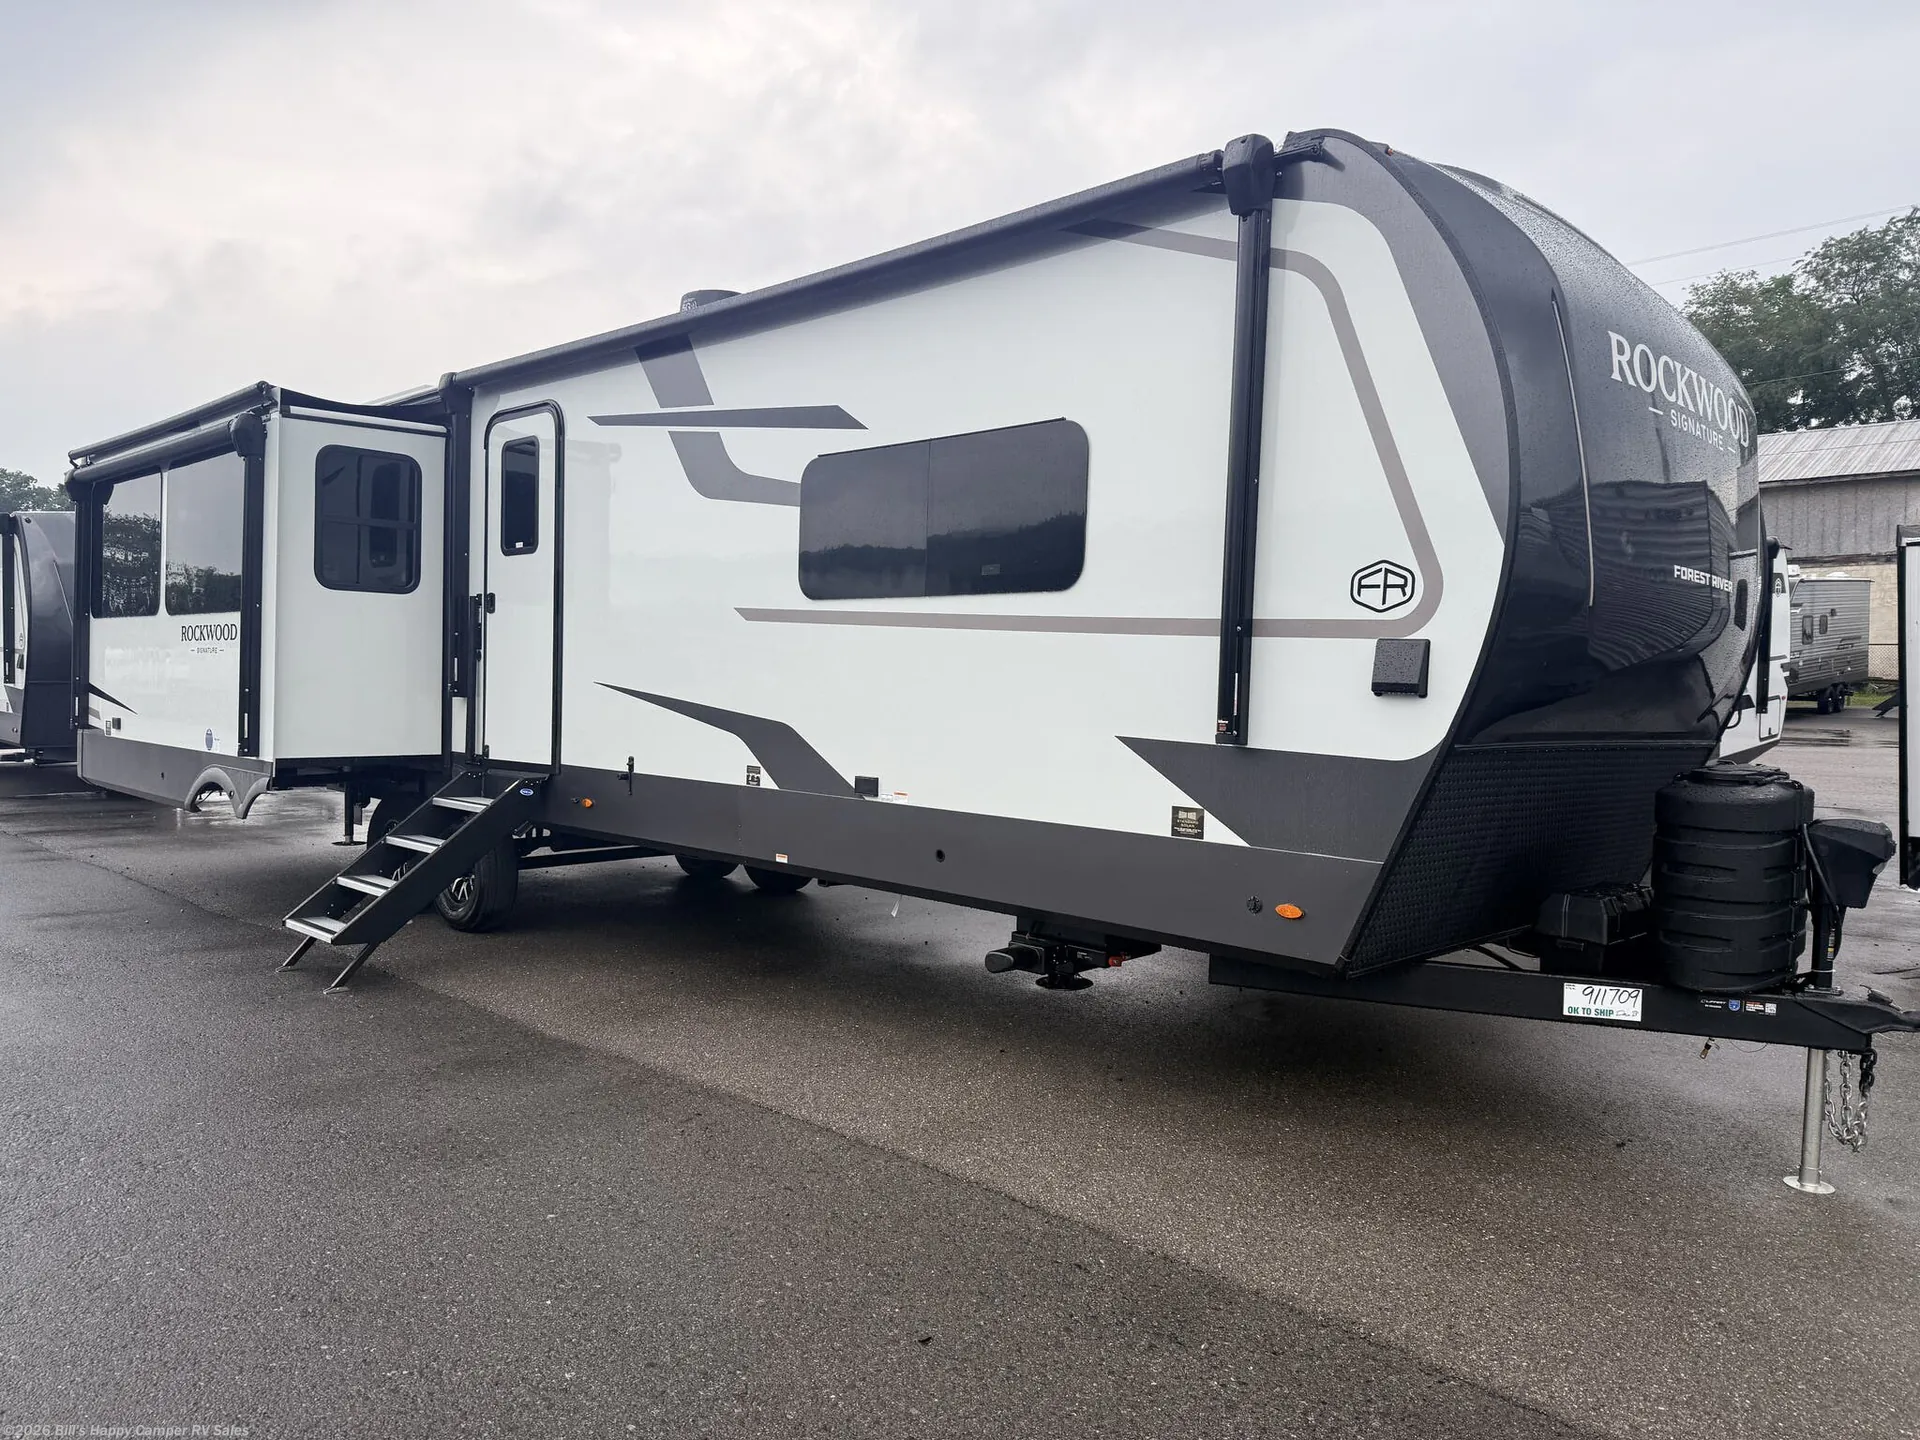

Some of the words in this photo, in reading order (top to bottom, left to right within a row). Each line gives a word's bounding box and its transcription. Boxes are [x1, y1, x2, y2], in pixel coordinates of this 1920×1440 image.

[1608, 330, 1749, 448] ROCKWOOD
[1670, 409, 1724, 451] SIGNATURE
[1674, 564, 1710, 586] FOREST
[1711, 574, 1733, 593] RIVER
[181, 623, 238, 641] ROCKWOOD
[1582, 985, 1641, 1008] 911709
[1567, 1006, 1580, 1015] OK
[1581, 1007, 1592, 1016] TO
[1594, 1008, 1614, 1017] SHIP
